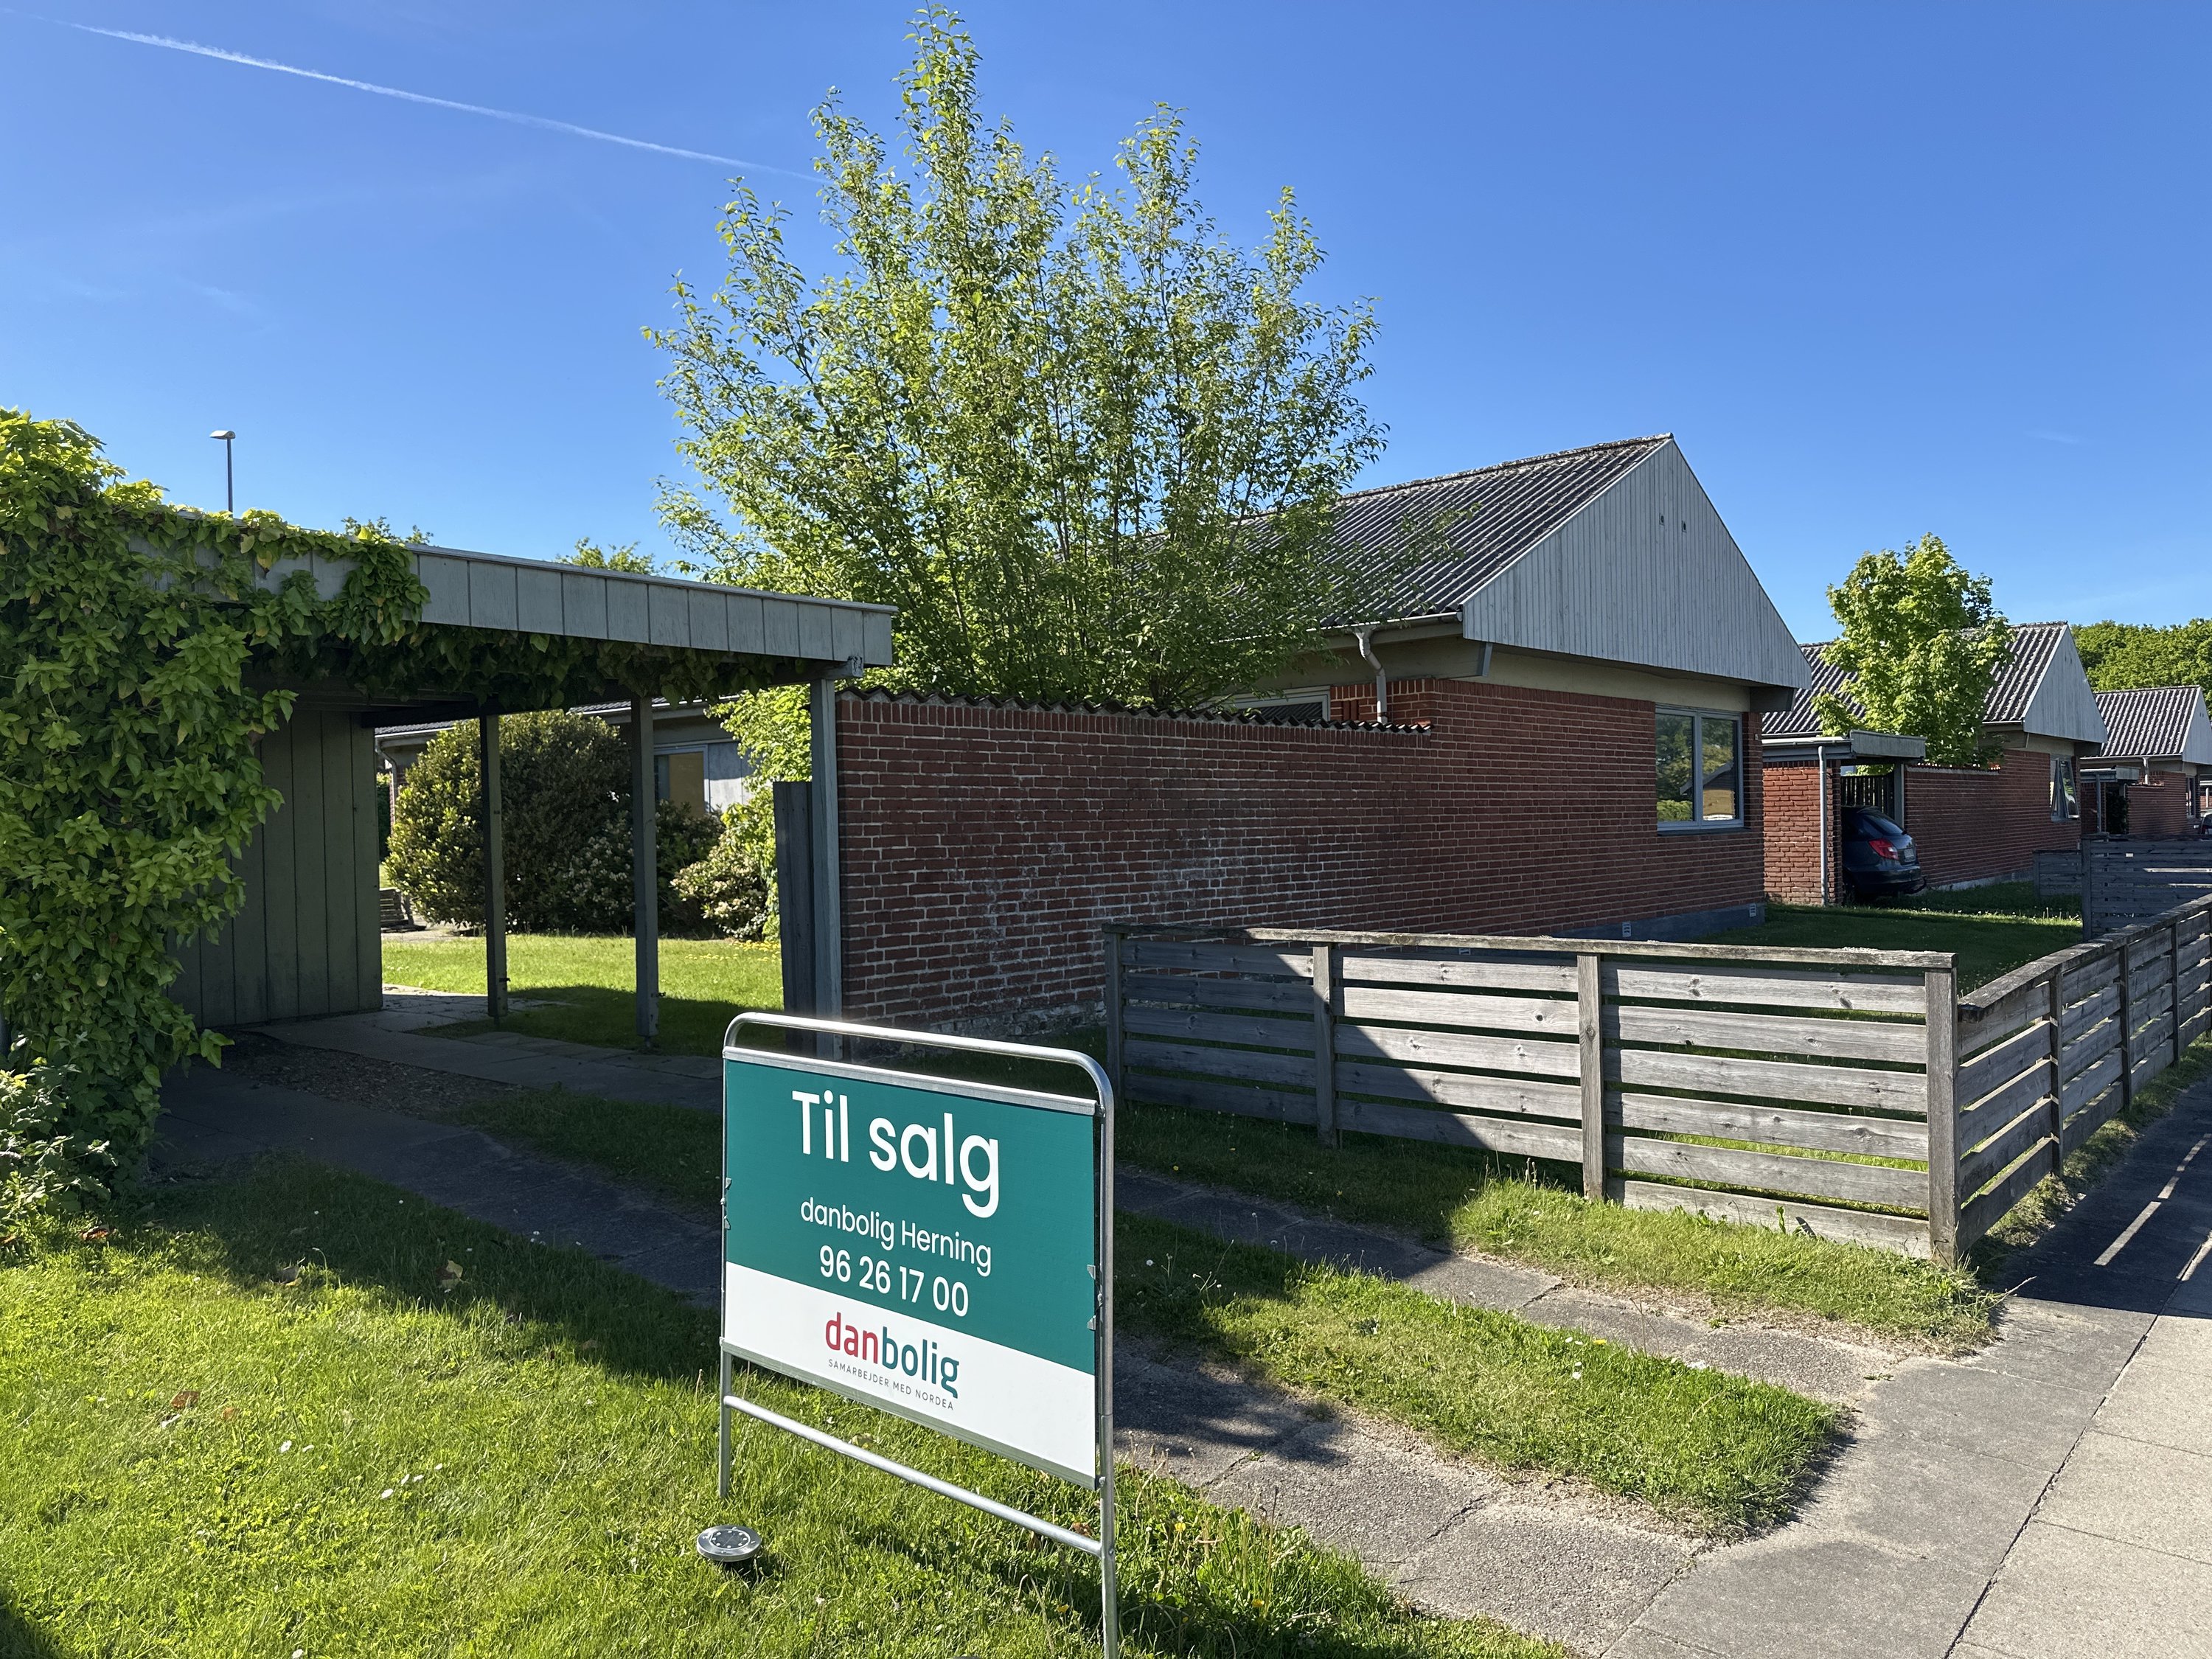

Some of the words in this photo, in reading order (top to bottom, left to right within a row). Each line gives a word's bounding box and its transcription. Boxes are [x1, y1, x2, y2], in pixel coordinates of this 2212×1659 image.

[792, 1090, 849, 1163] Til
[869, 1112, 999, 1218] salg
[800, 1197, 894, 1251] danbolig
[901, 1220, 992, 1278] Herning
[819, 1245, 851, 1282] 96
[859, 1256, 891, 1294] 26
[899, 1265, 925, 1304] 17
[933, 1276, 969, 1317] 00
[825, 1311, 960, 1399] danbolig
[828, 1358, 889, 1388] SAMARBEJDER
[892, 1380, 911, 1395] MED
[915, 1388, 954, 1411] NORDEA
